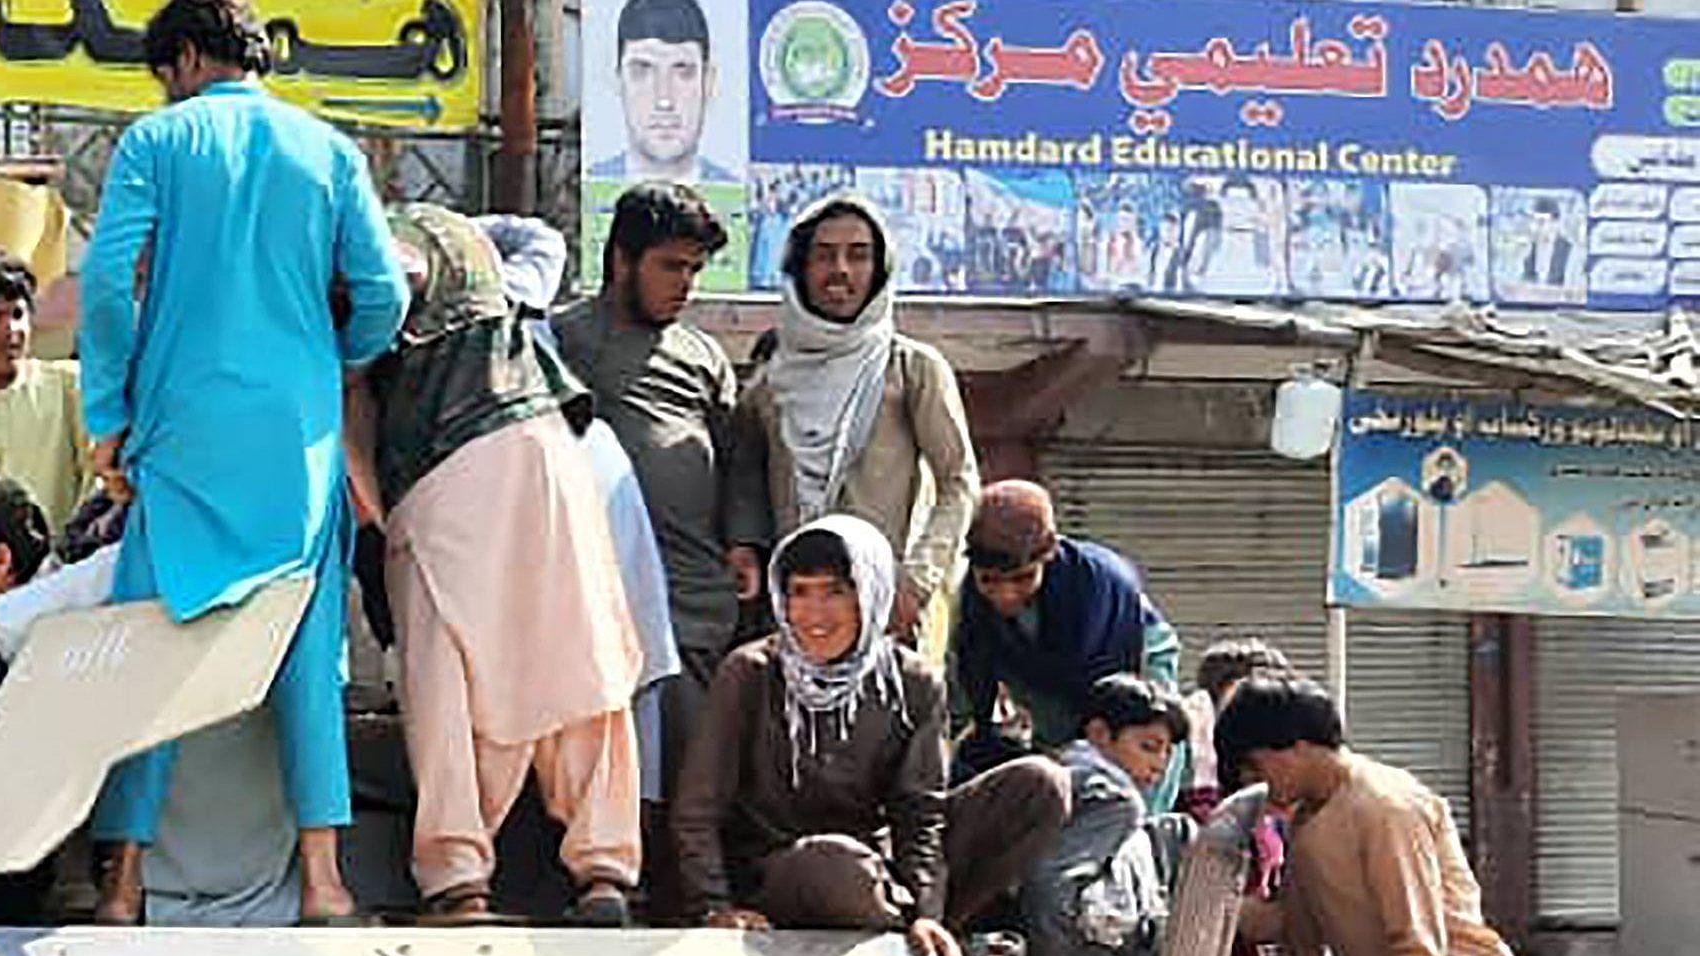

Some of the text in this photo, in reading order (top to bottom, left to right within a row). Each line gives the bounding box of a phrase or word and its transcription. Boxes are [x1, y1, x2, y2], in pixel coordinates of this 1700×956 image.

[874, 0, 1106, 100] مرکز
[1411, 37, 1615, 119] همدرد
[924, 129, 1458, 177] Hamdard Educational Center
